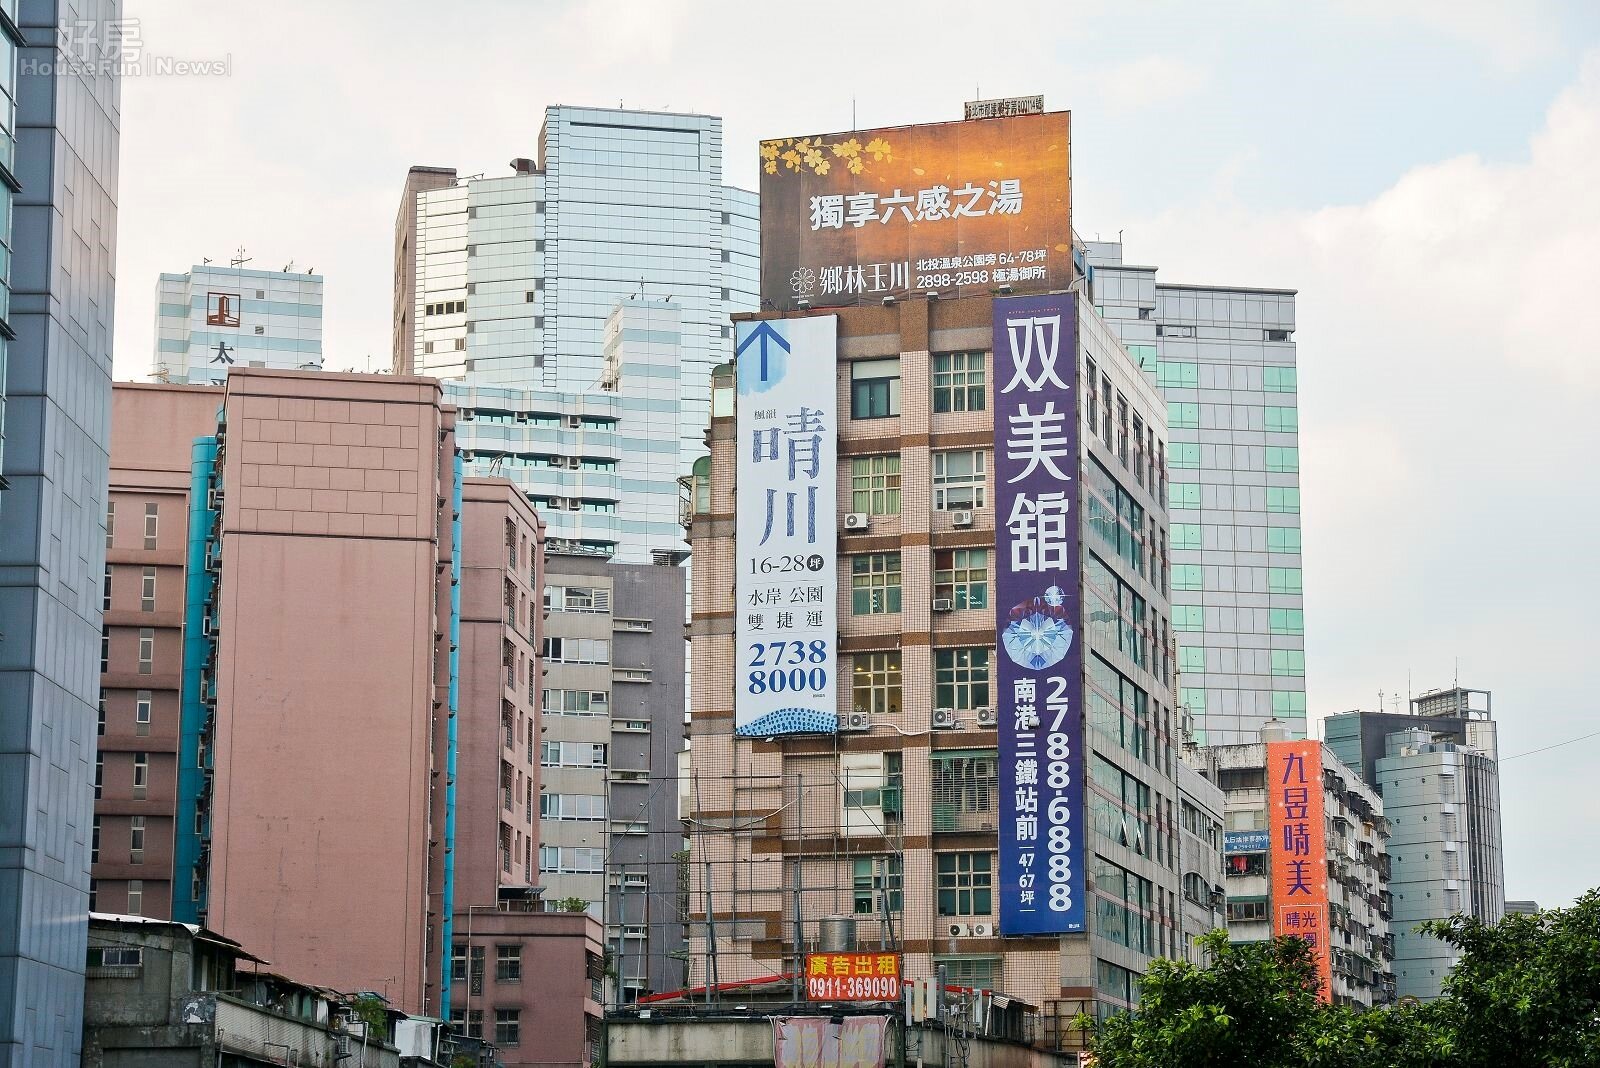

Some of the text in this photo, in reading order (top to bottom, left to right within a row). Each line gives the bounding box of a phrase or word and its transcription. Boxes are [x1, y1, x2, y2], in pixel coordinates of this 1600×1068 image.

[809, 178, 1023, 231] 獨享六感之湯
[999, 249, 1047, 265] 64-78坪
[819, 261, 909, 296] 鄉林玉川
[916, 265, 1047, 289] 2898-2598 極湯御所
[1000, 315, 1072, 572] 双美舘
[753, 406, 827, 546] 晴川
[749, 553, 824, 574] 16-28坪
[748, 585, 823, 606] 水岸 公園
[749, 639, 827, 667] 2738
[749, 667, 827, 695] 8000
[1014, 677, 1038, 905] 南港三鐵站前 47-67坪
[1046, 676, 1072, 912] 2788-6888
[1282, 752, 1313, 896] 九昱晴美
[1286, 910, 1317, 929] 晴光
[810, 955, 896, 975] 廣告出租
[809, 977, 897, 998] 0911-369090
